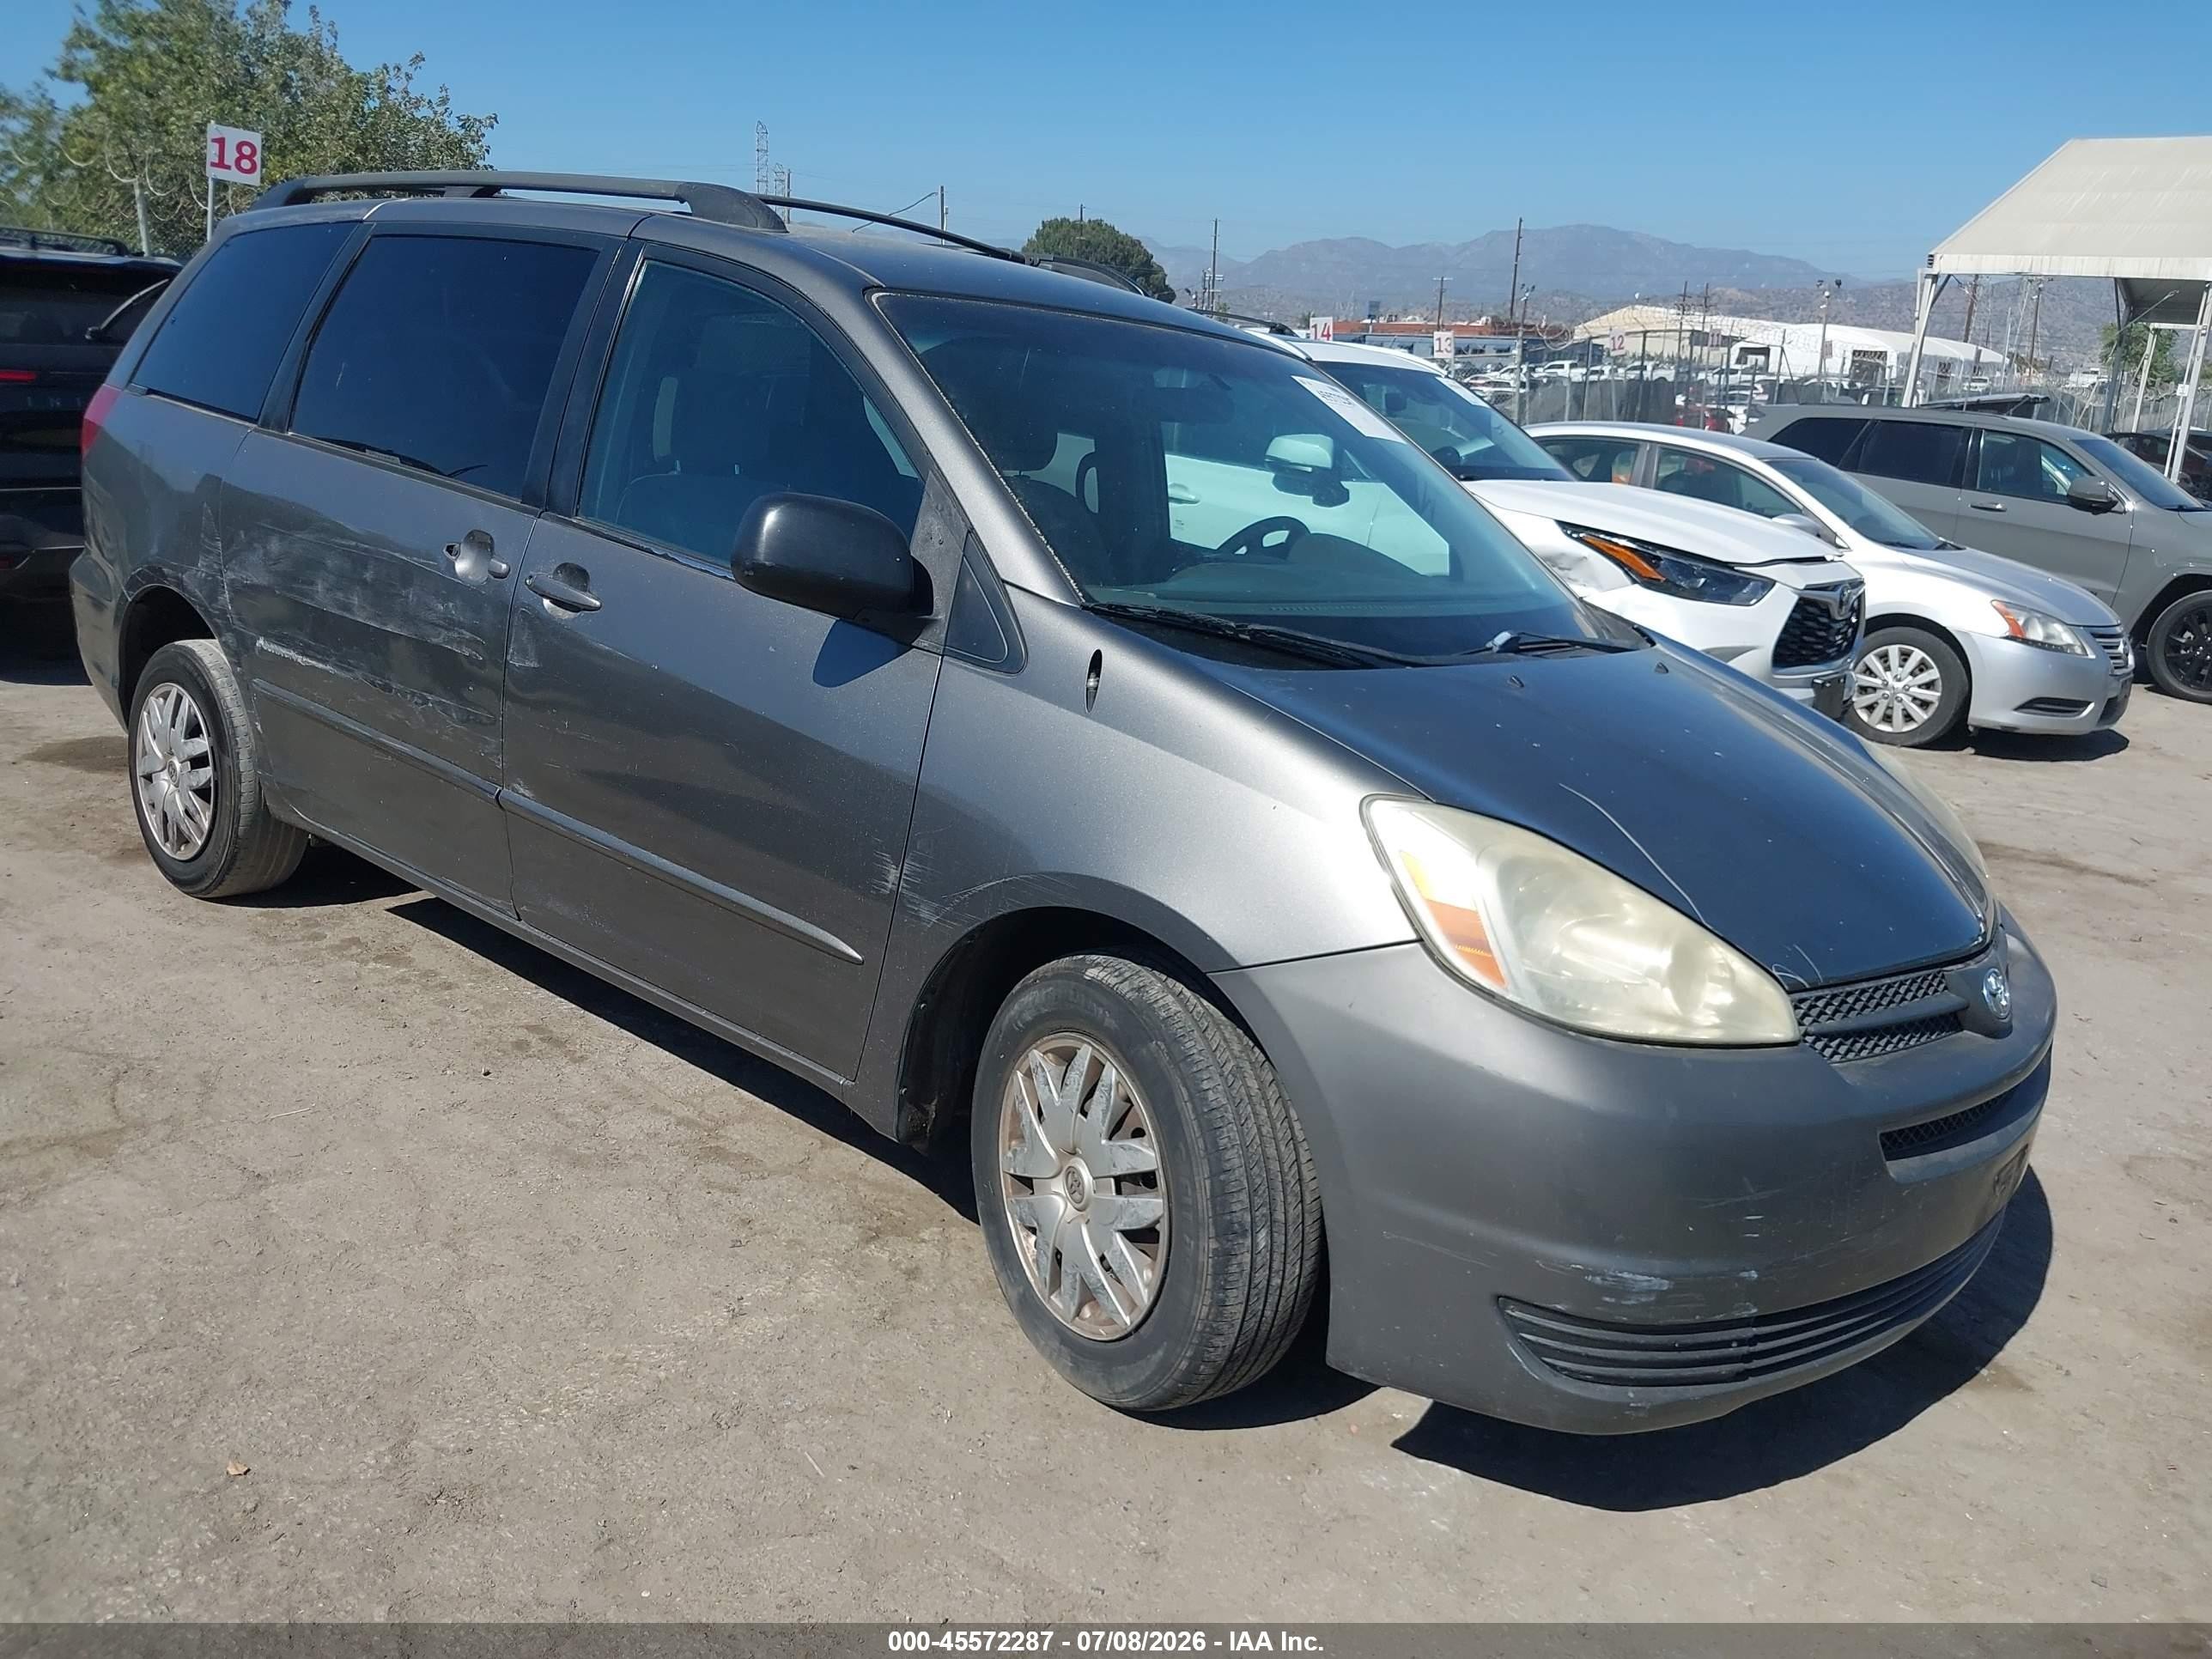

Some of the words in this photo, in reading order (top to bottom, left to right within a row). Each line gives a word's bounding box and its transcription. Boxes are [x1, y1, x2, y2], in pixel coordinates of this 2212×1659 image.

[210, 137, 258, 174] 18
[1311, 322, 1332, 342] 14
[1434, 336, 1453, 353] 13
[1610, 335, 1626, 352] 12
